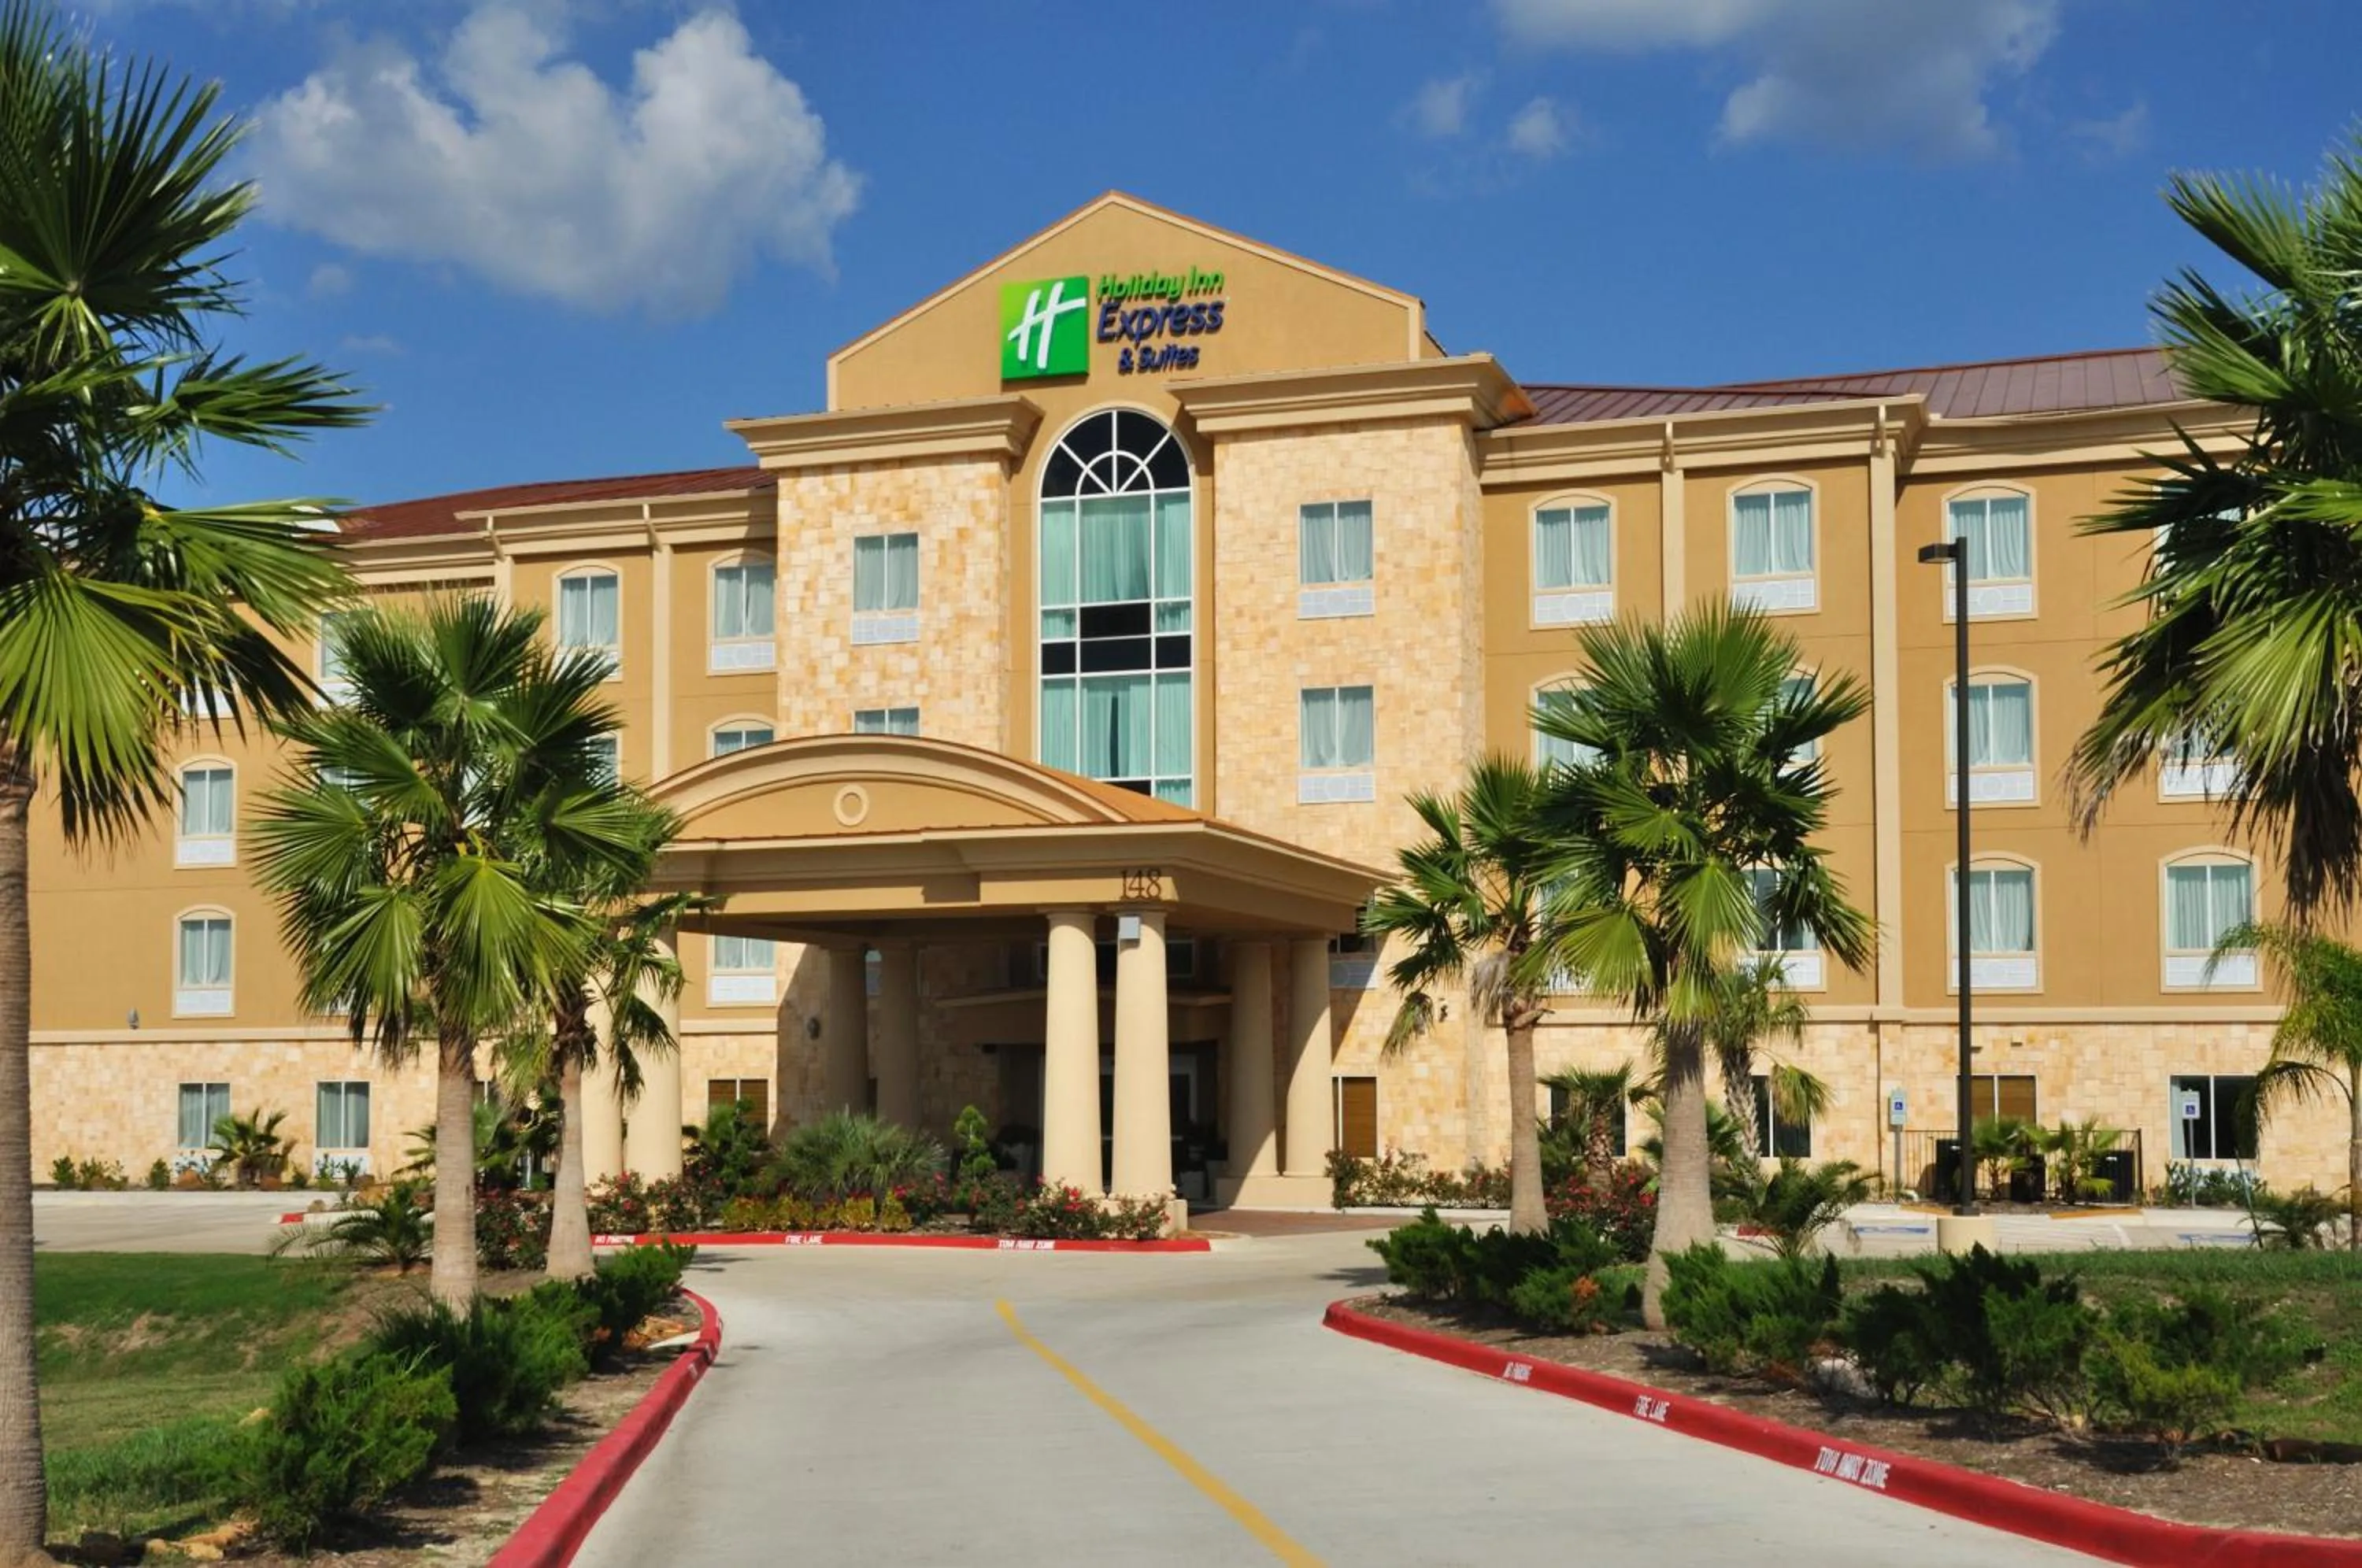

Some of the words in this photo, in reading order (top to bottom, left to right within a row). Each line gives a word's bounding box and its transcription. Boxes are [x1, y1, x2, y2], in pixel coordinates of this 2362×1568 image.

[1097, 272, 1184, 301] Holiday
[1187, 266, 1225, 296] Inn
[1097, 301, 1225, 347] Express
[1118, 347, 1134, 375] &
[1136, 344, 1200, 375] Suites
[1120, 868, 1161, 900] 148
